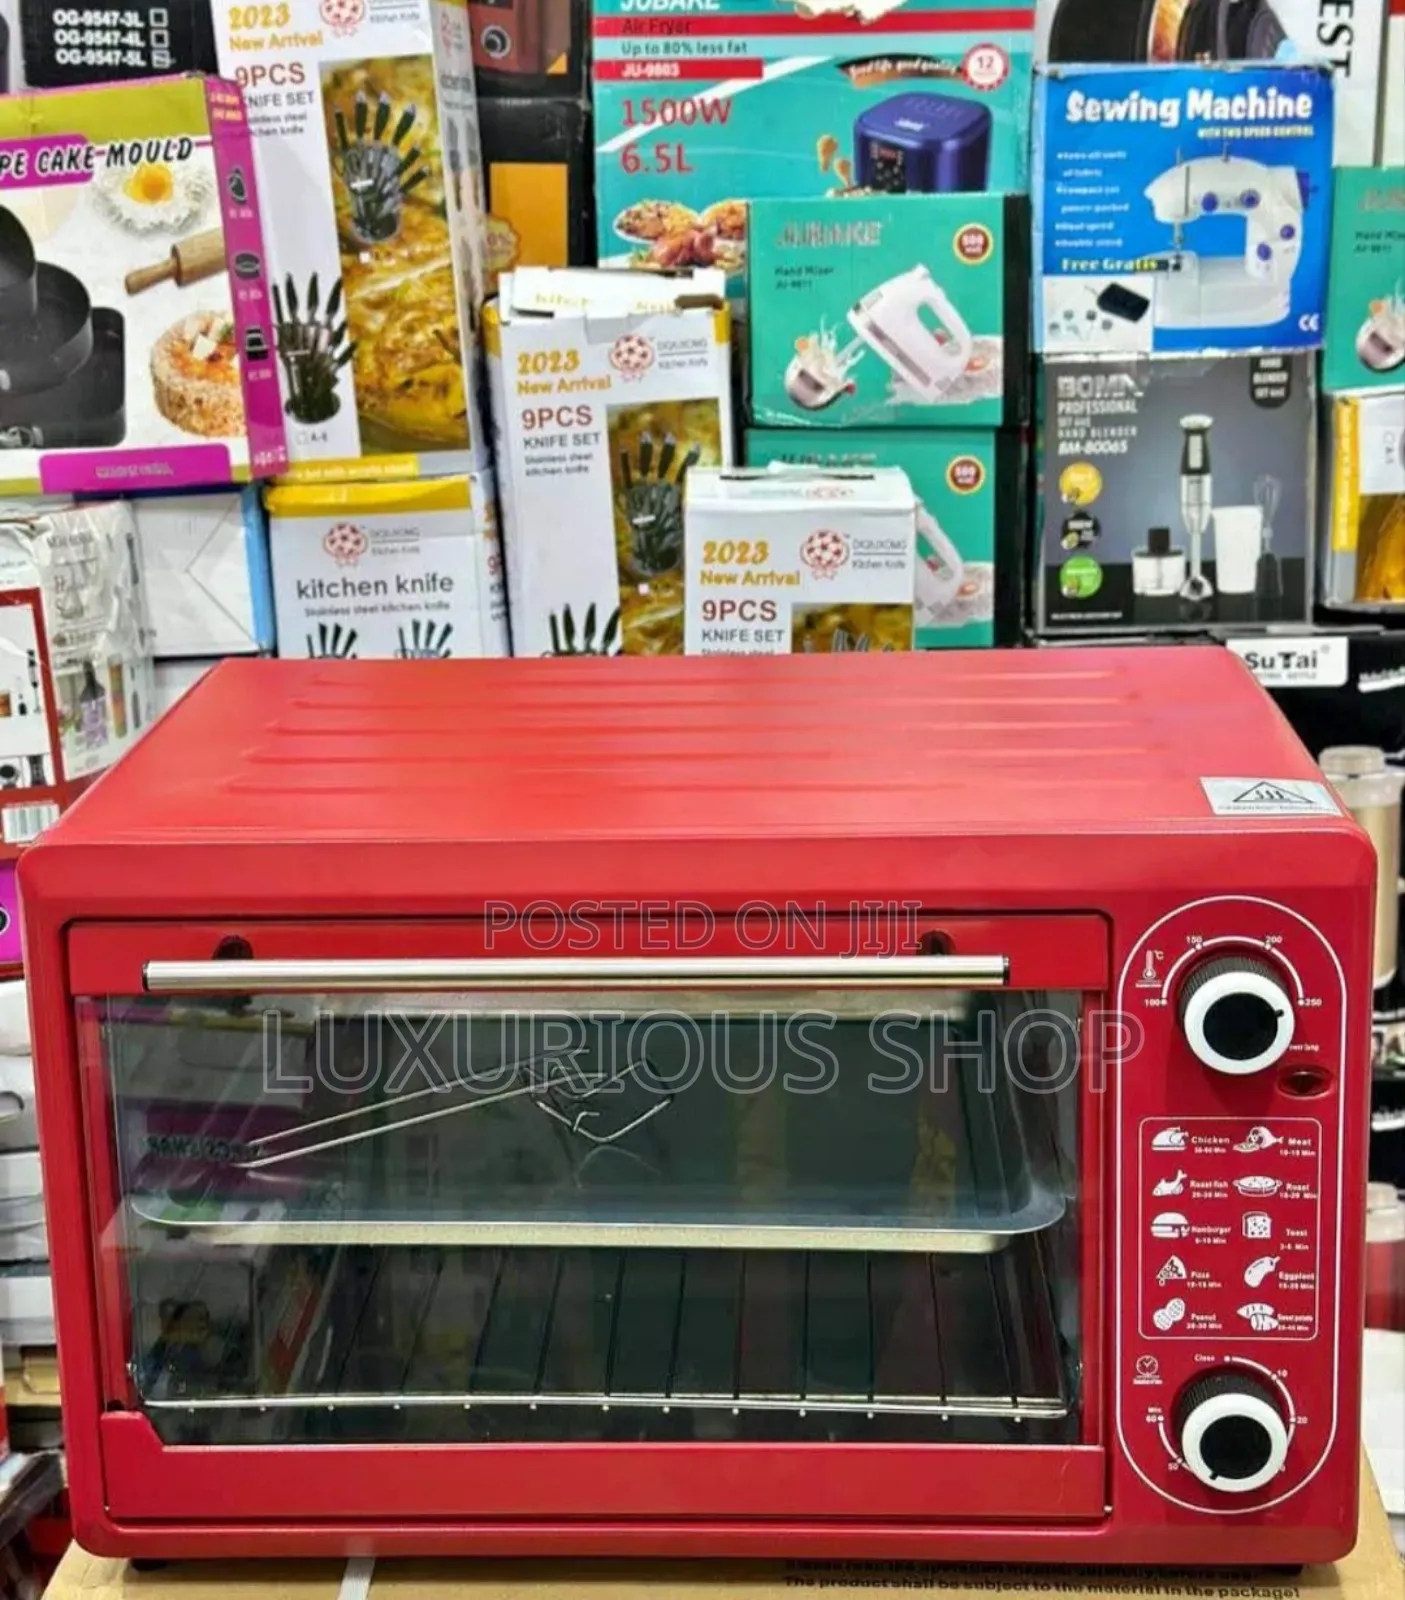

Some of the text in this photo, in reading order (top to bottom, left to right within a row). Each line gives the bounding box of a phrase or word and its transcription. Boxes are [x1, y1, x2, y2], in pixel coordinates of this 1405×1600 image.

[228, 3, 291, 30] 2023
[622, 18, 692, 37] Air Fryer
[229, 30, 324, 52] New Arrival
[621, 40, 748, 56] Up to 80% less fat
[234, 62, 306, 88] 9PCS
[247, 93, 284, 108] NIFE
[287, 91, 315, 104] SET
[1066, 87, 1313, 128] Sewing Machine
[622, 97, 732, 127] 1500W
[38, 146, 95, 174] CAKE
[105, 136, 194, 169] MOULD
[621, 142, 692, 174] 6.5L
[1062, 258, 1157, 271] Free Gratis
[516, 349, 580, 375] 2023
[517, 374, 612, 395] New Arrival
[522, 403, 593, 430] 9PCS
[1057, 400, 1137, 415] PROFESSIONAL
[523, 432, 600, 449] KNIFE SET
[703, 540, 769, 565] 2023
[296, 573, 454, 600] kitchen knife
[700, 571, 801, 586] New Arrival
[702, 599, 777, 622] 9PCS
[702, 628, 784, 643] KNIFE SET
[1245, 650, 1317, 669] SuTai
[1265, 935, 1283, 944] 200
[1191, 1136, 1230, 1145] Chicken
[1288, 1137, 1312, 1147] Meat
[1191, 1313, 1217, 1322] Peanut
[786, 1576, 816, 1588] The
[819, 1577, 888, 1591] product
[892, 1578, 934, 1590] shall
[939, 1579, 960, 1591] be
[963, 1579, 1031, 1595] subject
[1033, 1582, 1049, 1592] to
[1055, 1582, 1081, 1593] the
[1086, 1584, 1160, 1597] material
[1163, 1585, 1183, 1597] in
[1186, 1586, 1214, 1599] the
